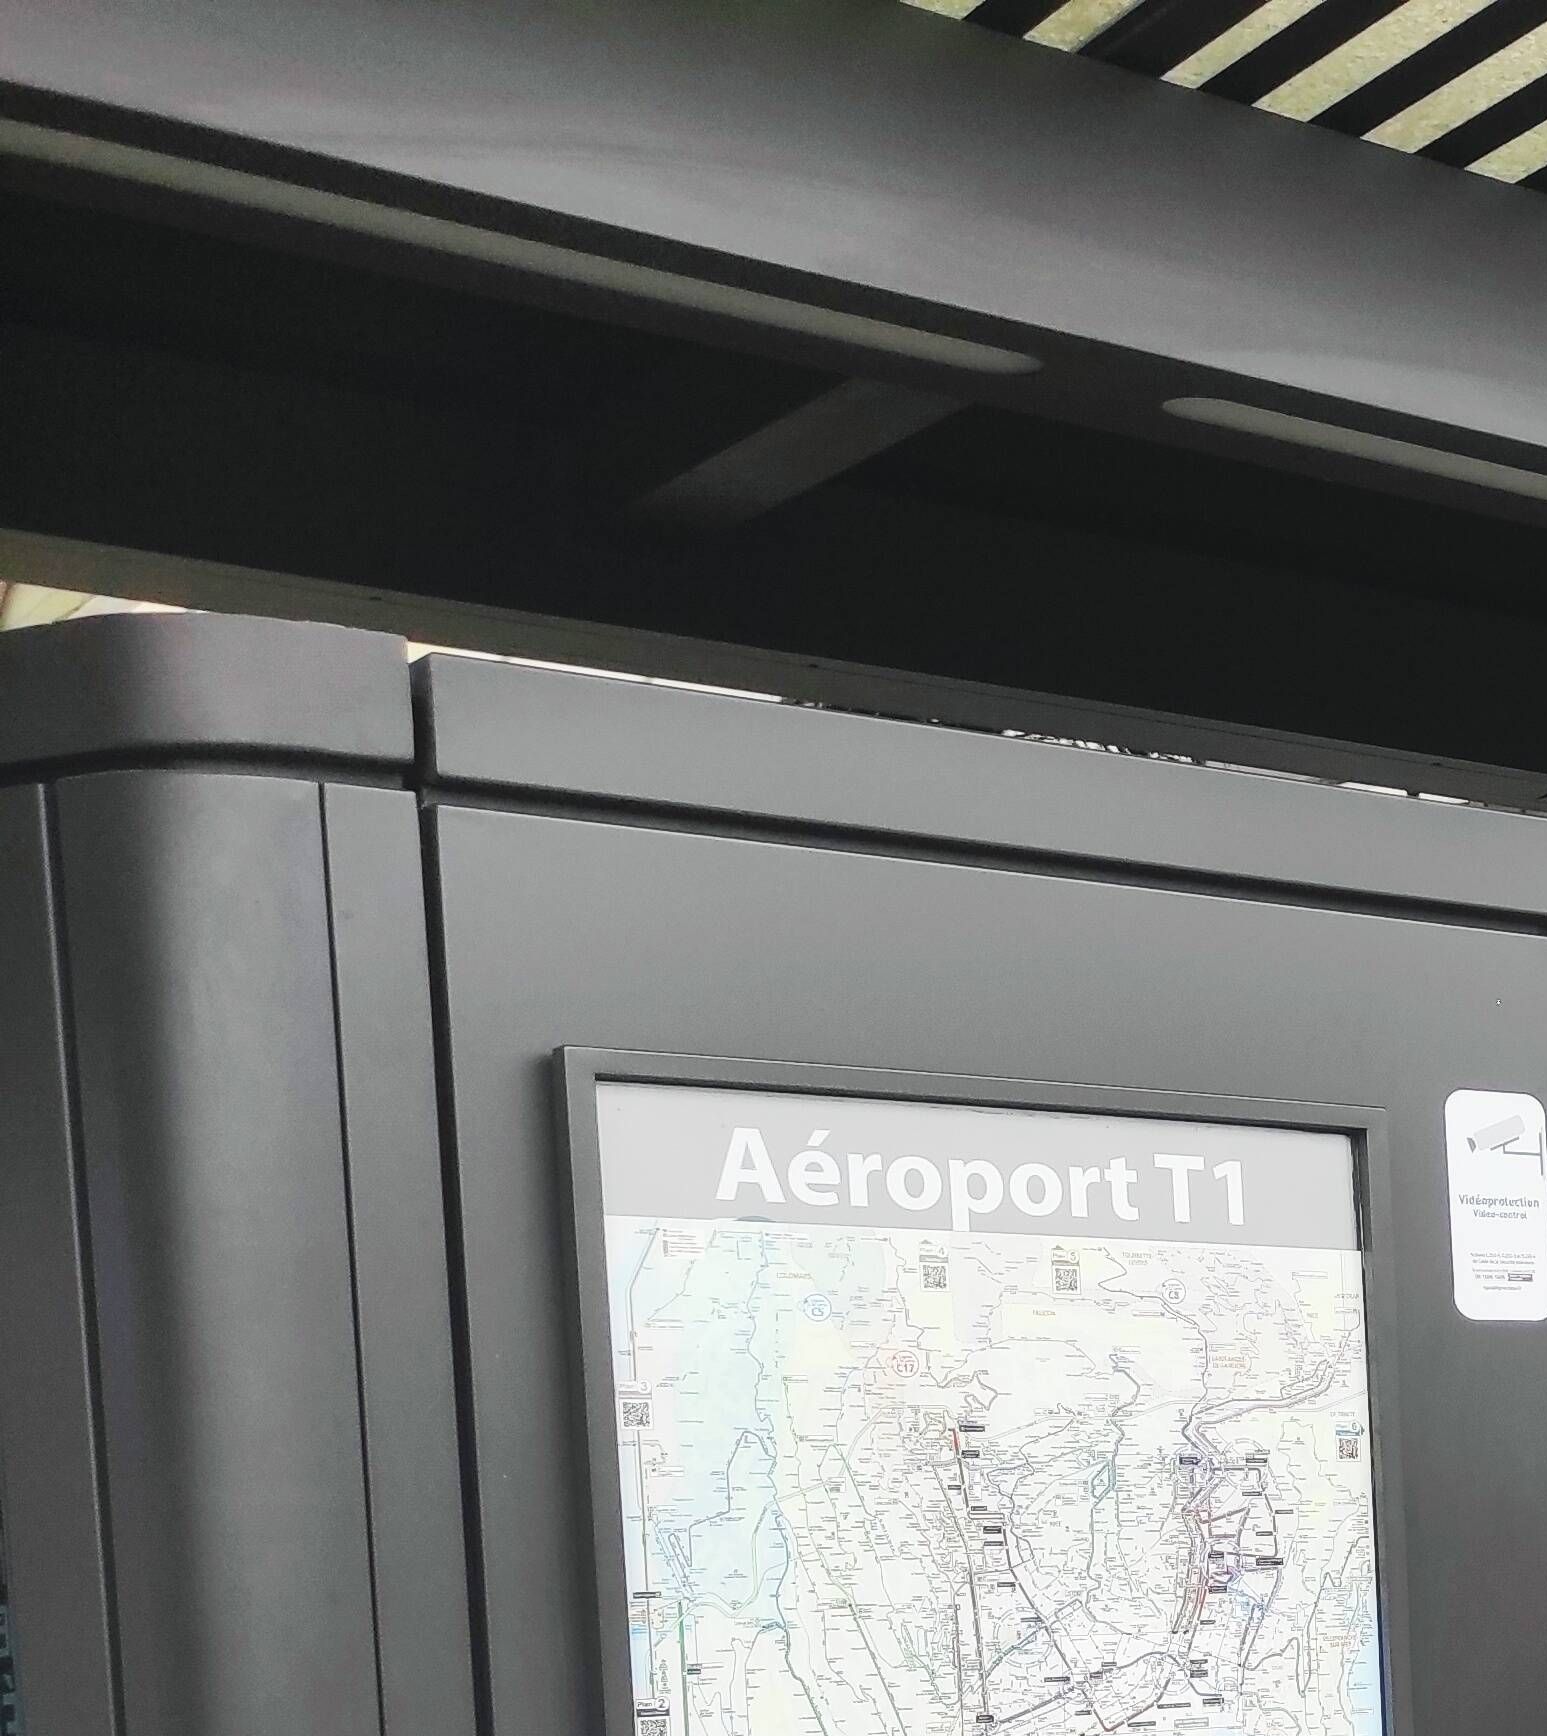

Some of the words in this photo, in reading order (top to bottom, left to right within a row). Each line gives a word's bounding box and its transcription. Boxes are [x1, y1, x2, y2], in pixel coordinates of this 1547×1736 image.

[716, 1127, 1139, 1230] Aéroport
[1154, 1153, 1245, 1225] T1
[658, 1699, 665, 1708] 2
